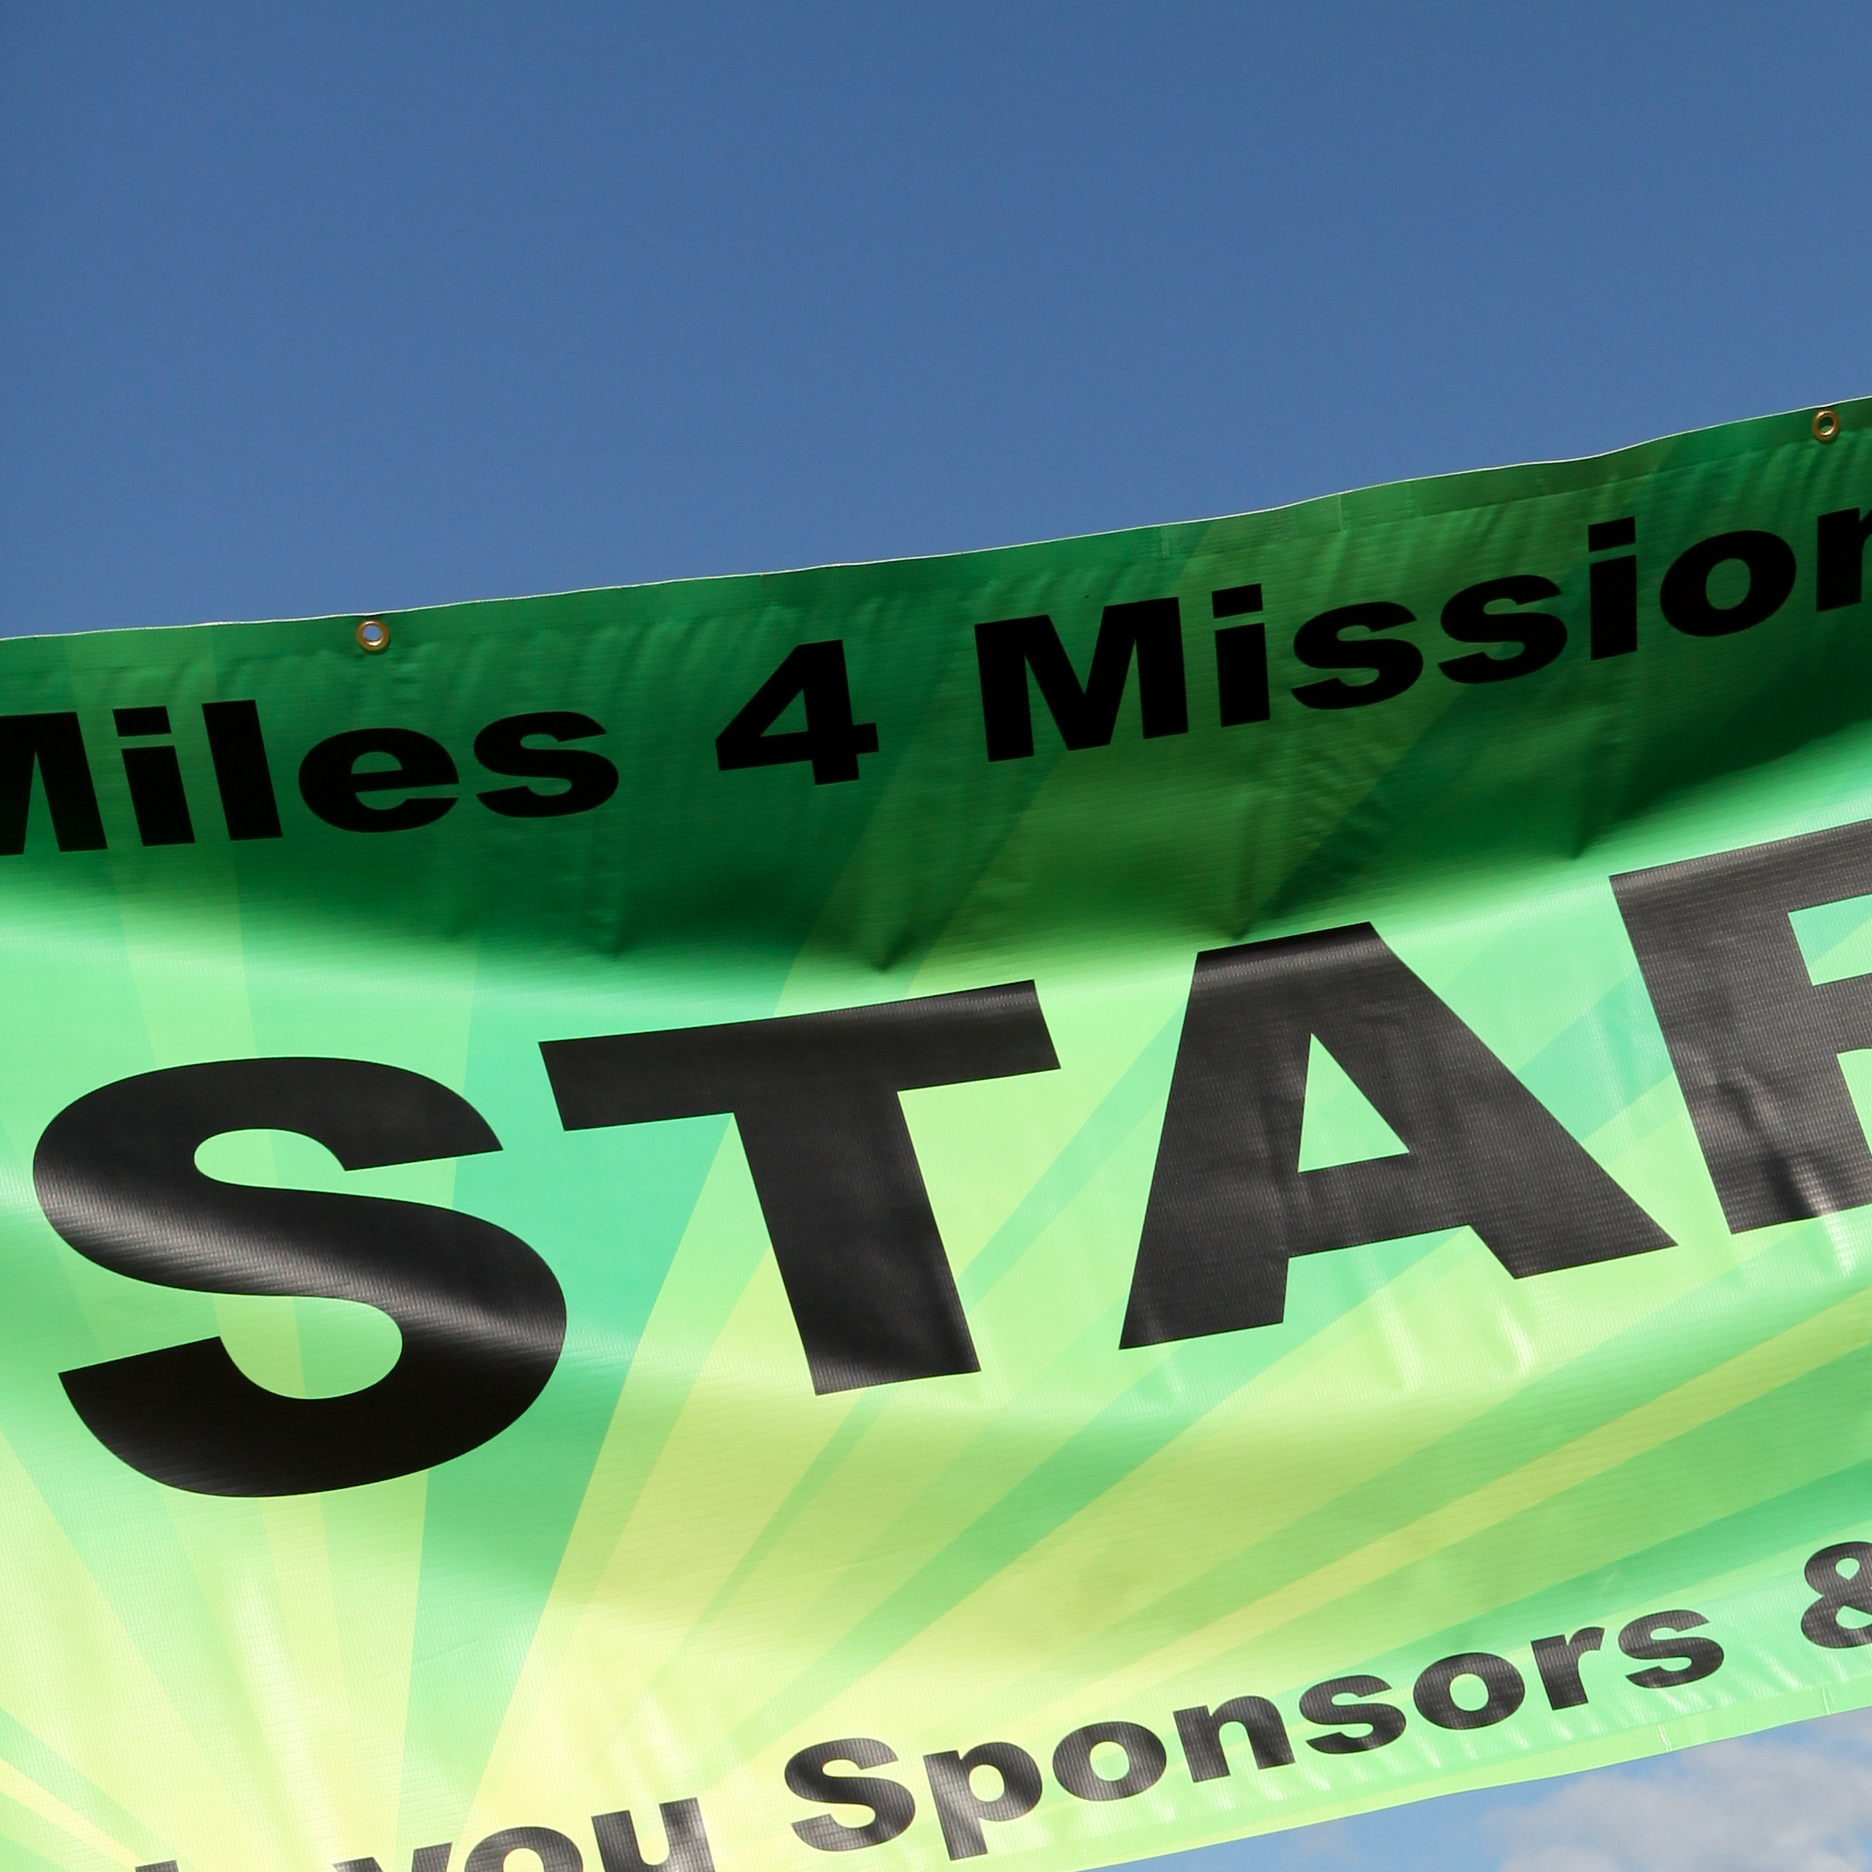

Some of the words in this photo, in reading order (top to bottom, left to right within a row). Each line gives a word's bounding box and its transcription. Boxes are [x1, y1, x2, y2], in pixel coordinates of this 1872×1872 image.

[0, 699, 620, 856] Miles
[714, 639, 880, 787] 4
[784, 1609, 1725, 1861] Sponsors
